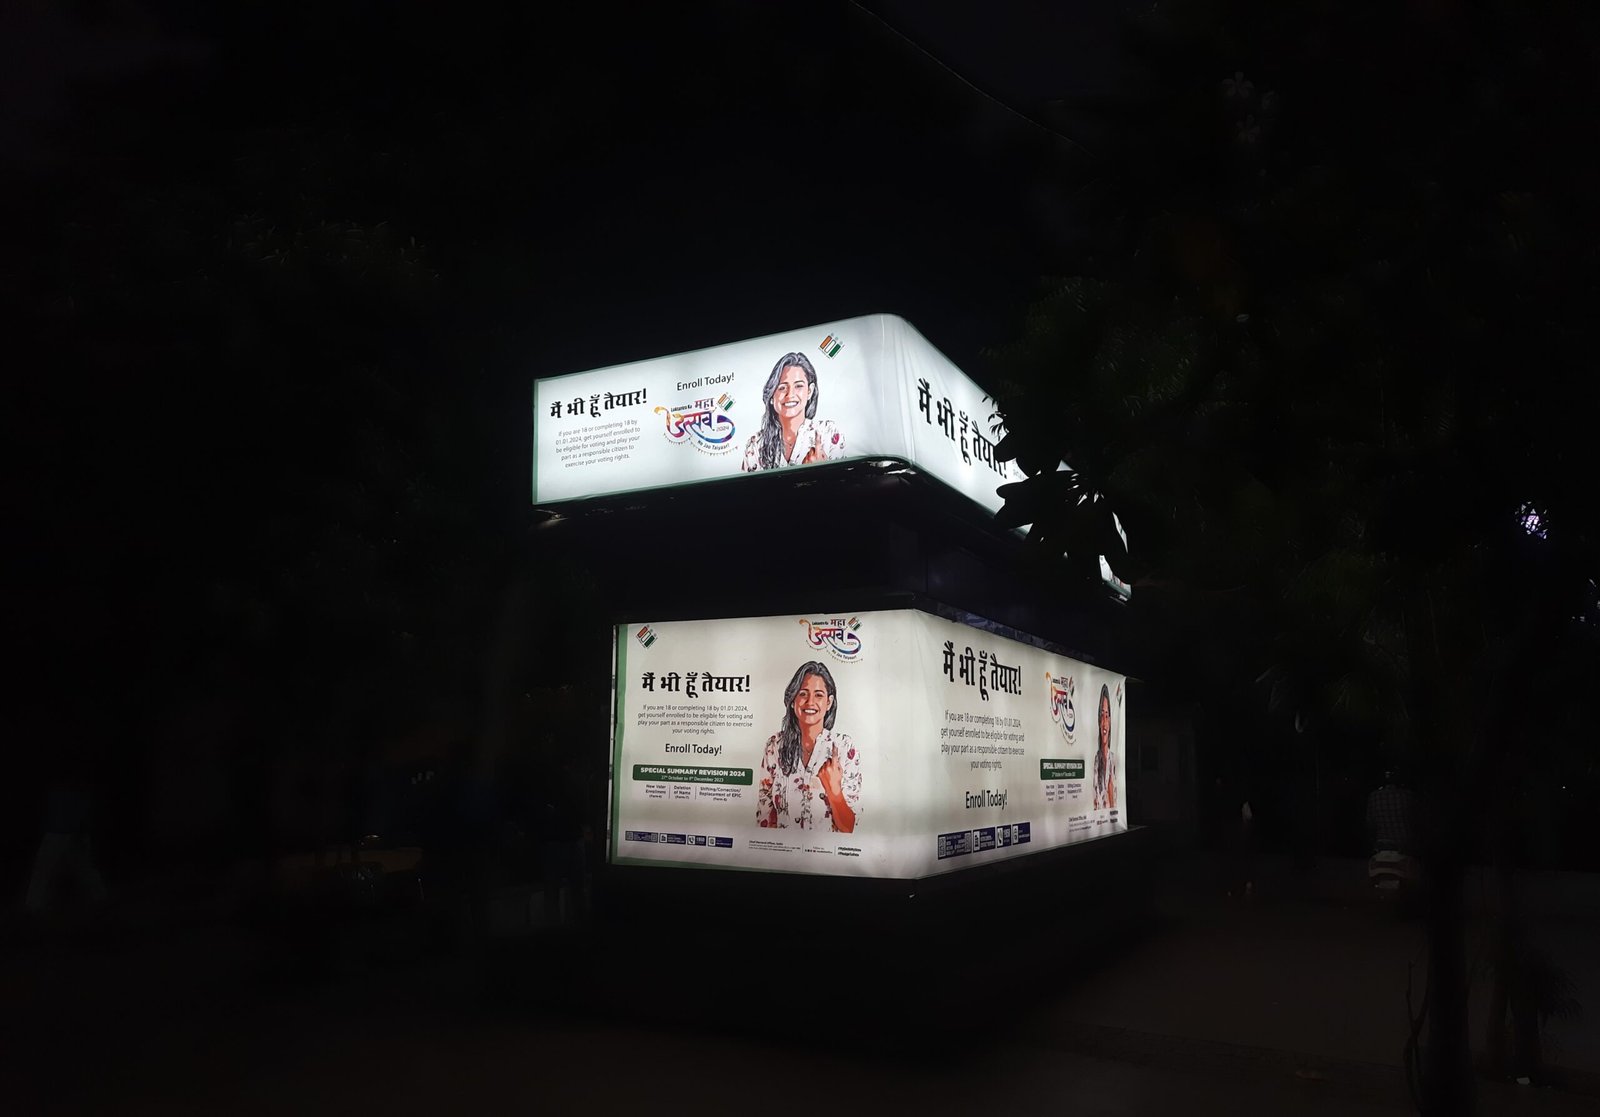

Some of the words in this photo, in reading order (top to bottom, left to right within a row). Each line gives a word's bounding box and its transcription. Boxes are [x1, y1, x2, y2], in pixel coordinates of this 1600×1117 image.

[677, 378, 702, 391] Enroll
[705, 372, 734, 385] Today!
[550, 401, 562, 418] मैं
[567, 398, 585, 415] भी
[590, 394, 601, 418] हूँ
[604, 388, 647, 410] तैयार!
[695, 398, 714, 410] महा
[595, 422, 623, 431] completing
[918, 378, 932, 424] मैं
[937, 397, 955, 441] भी
[959, 410, 971, 466] हूँ
[593, 430, 612, 440] yourself
[613, 428, 634, 436] enrolled
[563, 444, 580, 452] eligible
[582, 448, 610, 457] responsible
[830, 619, 846, 628] महा
[943, 640, 954, 682] मैं
[959, 646, 976, 686] भी
[978, 650, 989, 702] हूँ
[990, 653, 1022, 695] तैयार!
[642, 672, 655, 692] मैं
[661, 672, 681, 692] भी
[686, 672, 698, 698] हूँ
[702, 672, 750, 692] तैयार!
[949, 727, 965, 739] yourself
[665, 744, 690, 753] Enroll
[692, 744, 722, 756] Today!
[941, 742, 950, 755] play
[951, 745, 960, 756] your
[966, 790, 985, 808] Enroll
[987, 788, 1007, 810] Today!
